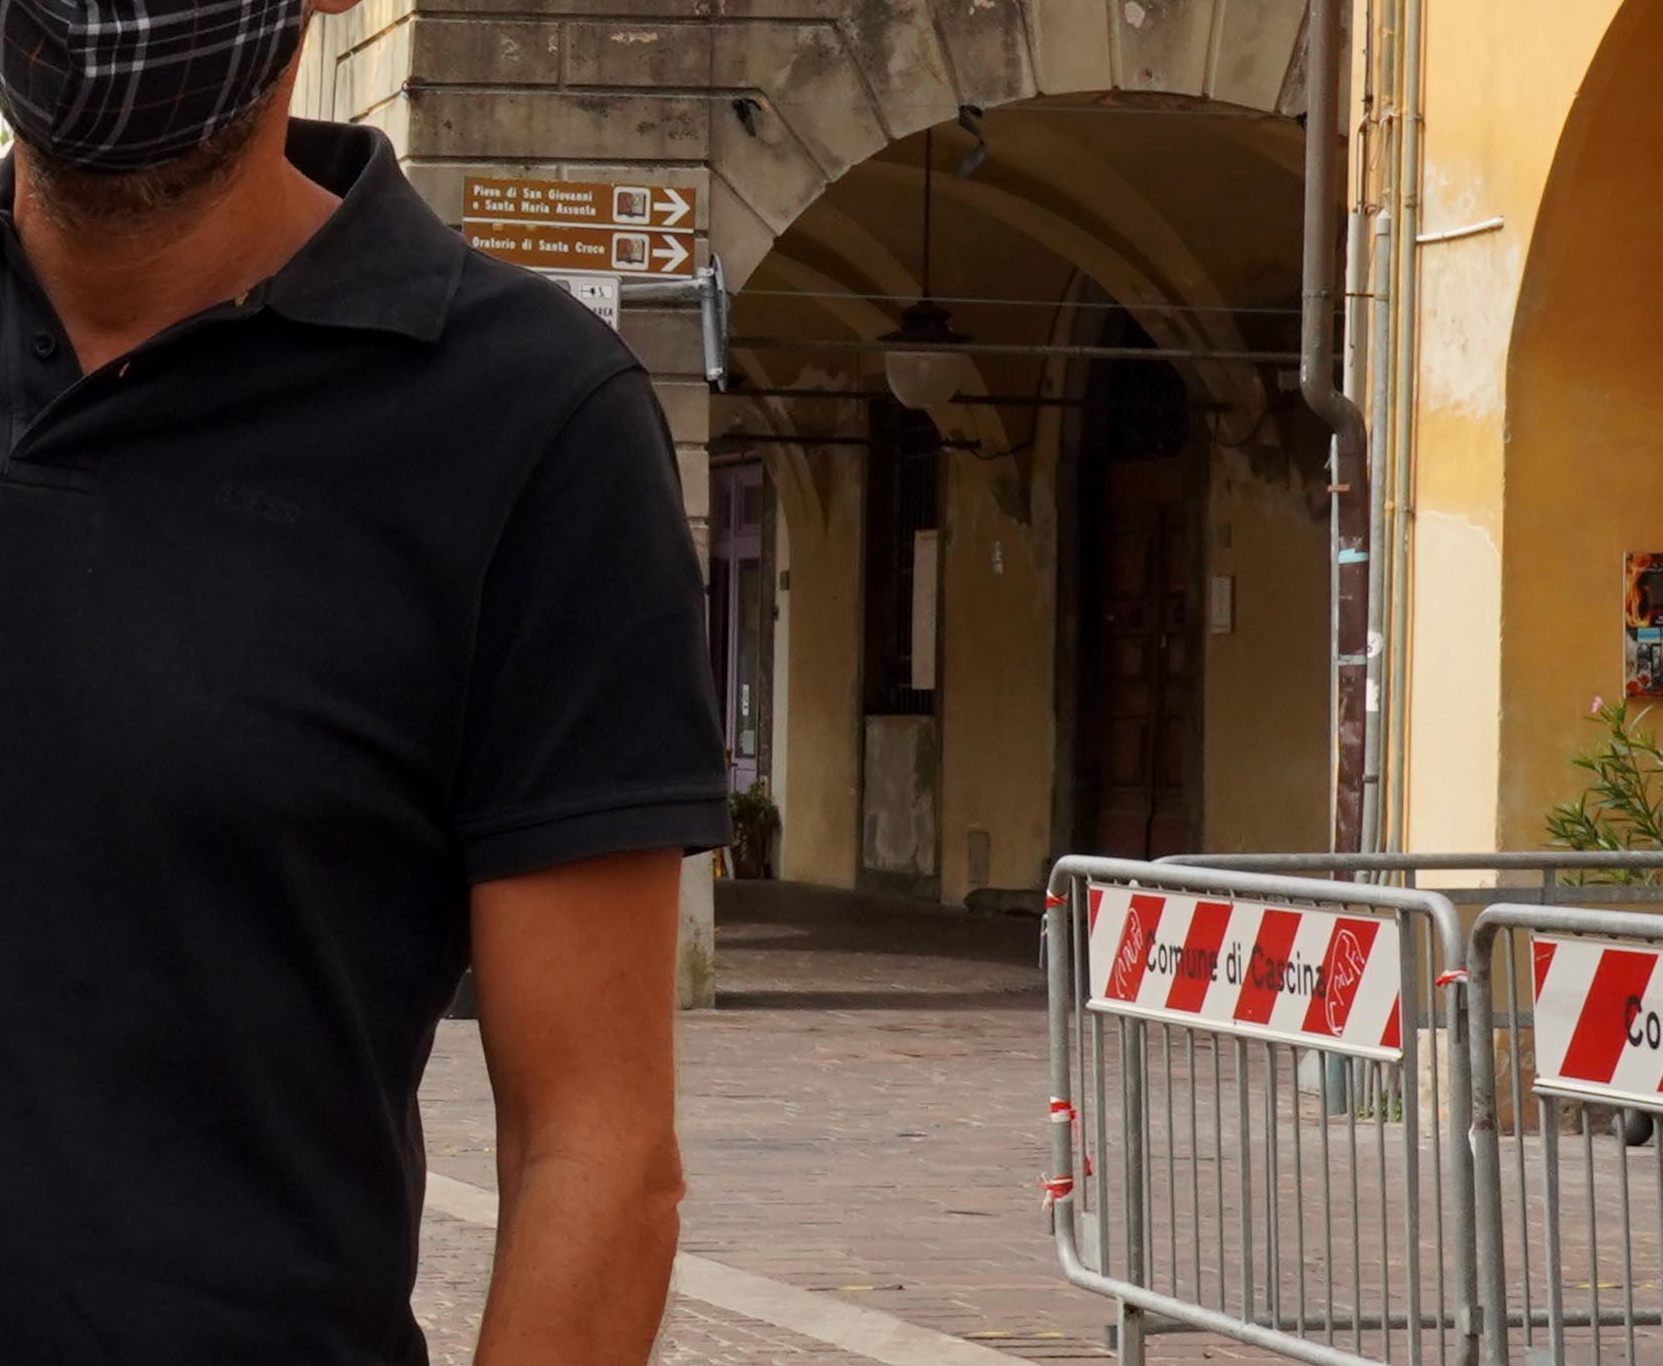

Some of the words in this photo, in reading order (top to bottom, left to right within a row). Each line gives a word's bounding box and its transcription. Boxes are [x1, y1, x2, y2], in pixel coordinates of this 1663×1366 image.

[506, 186, 517, 198] di
[523, 187, 542, 200] San
[548, 189, 593, 202] Giovanni
[472, 201, 479, 210] e
[485, 199, 515, 212] Santa
[521, 201, 550, 214] Maria
[556, 203, 596, 216] Assunta
[472, 236, 516, 249] Oratorio
[522, 238, 532, 250] di
[539, 239, 569, 252] Santa
[575, 241, 606, 254] Croce
[1146, 930, 1218, 983] Comune
[1226, 941, 1243, 985] di
[1251, 944, 1327, 999] Cascina
